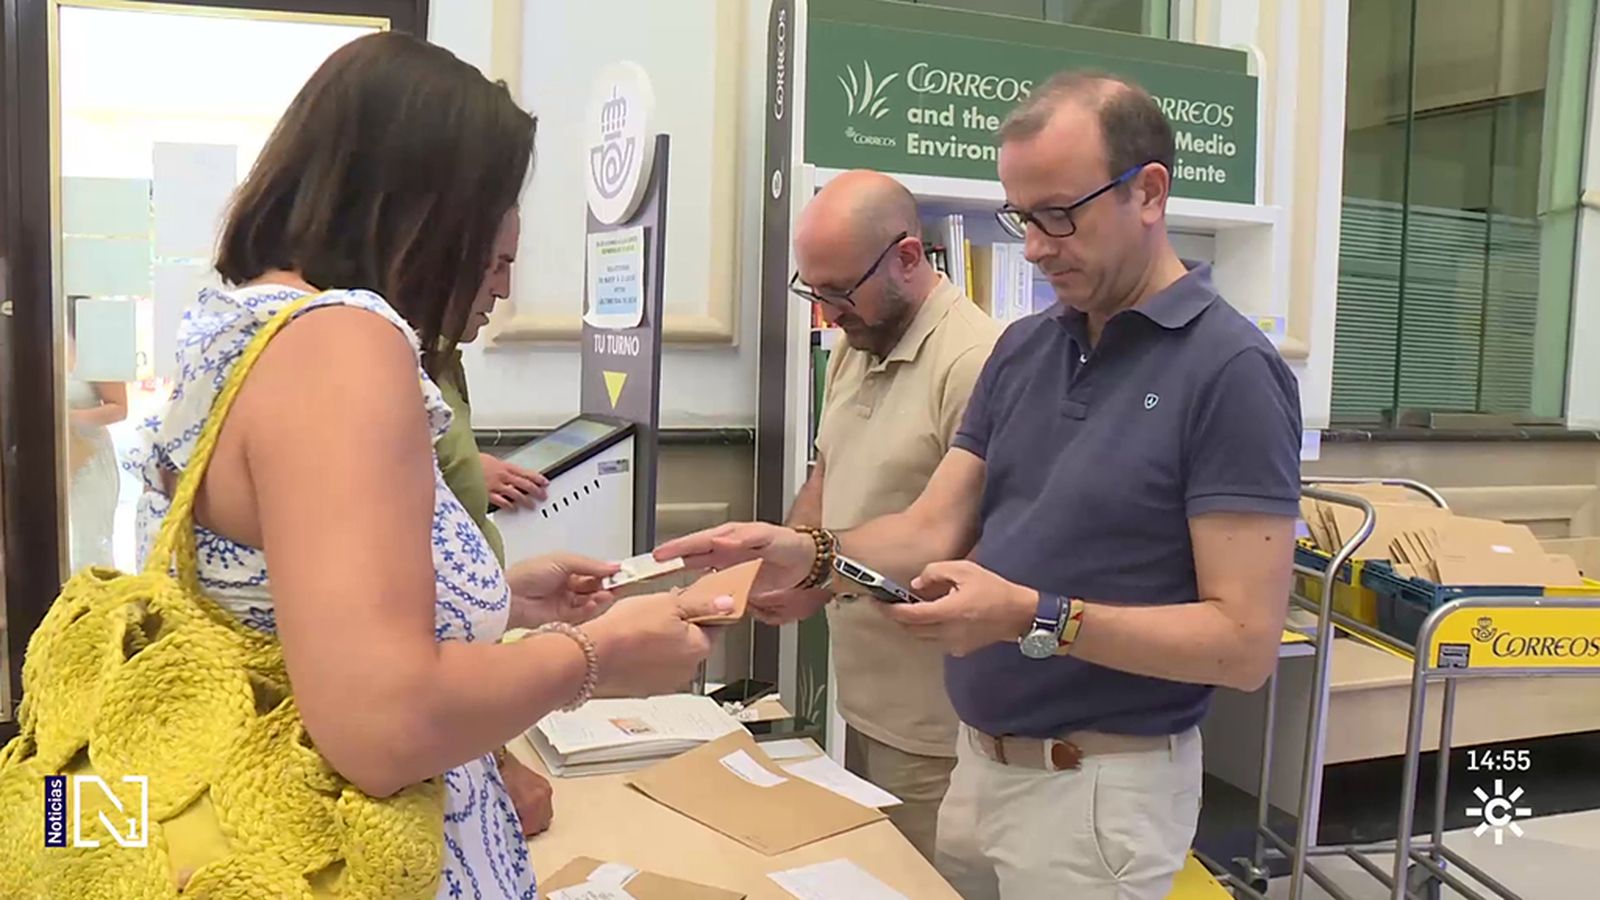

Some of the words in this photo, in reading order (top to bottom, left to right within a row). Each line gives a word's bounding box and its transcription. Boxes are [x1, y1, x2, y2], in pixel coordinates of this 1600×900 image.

[773, 9, 787, 121] CORREOS
[906, 62, 1034, 103] CORREOS
[907, 103, 955, 127] and
[962, 106, 1000, 131] the
[1151, 95, 1235, 128] RREOS
[853, 133, 897, 147] CORREOS
[907, 132, 1003, 162] Environ
[1174, 130, 1237, 157] Medio
[1172, 158, 1227, 184] iente
[593, 333, 606, 353] TU
[607, 334, 640, 356] TURNO
[1492, 632, 1600, 658] CORREOS
